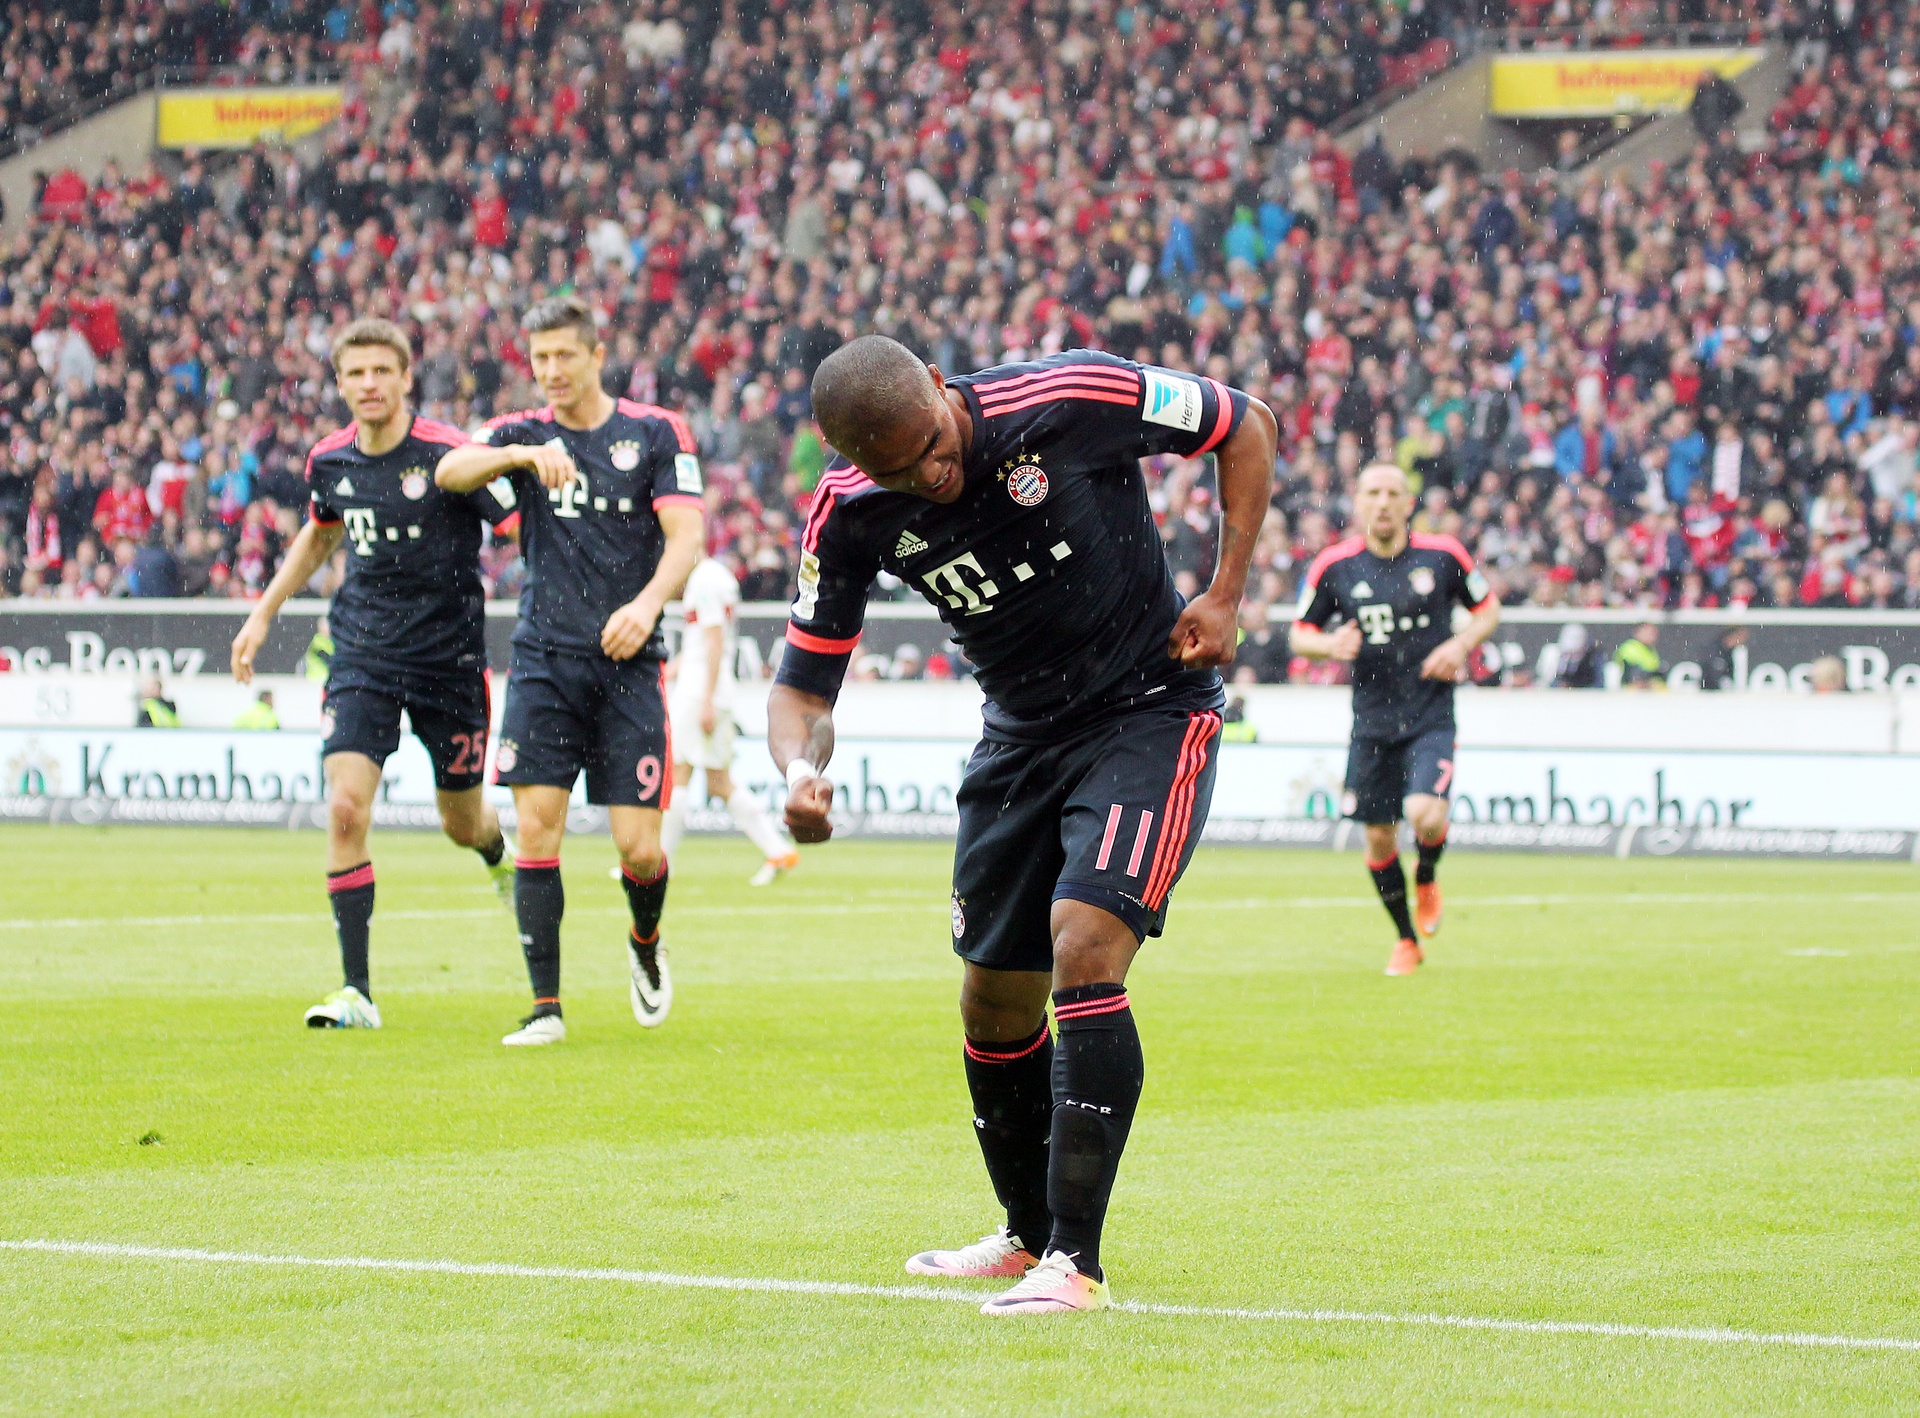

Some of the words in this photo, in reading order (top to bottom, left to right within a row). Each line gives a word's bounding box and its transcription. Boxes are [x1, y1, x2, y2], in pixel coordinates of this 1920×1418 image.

[1012, 467, 1042, 480] BAYERN
[895, 540, 929, 559] adidas
[79, 741, 402, 799] Krombacr
[447, 730, 485, 775] 25
[635, 755, 663, 801] 9
[1434, 758, 1454, 793] 7
[1450, 767, 1753, 828] ombacher
[1095, 803, 1155, 878] 11
